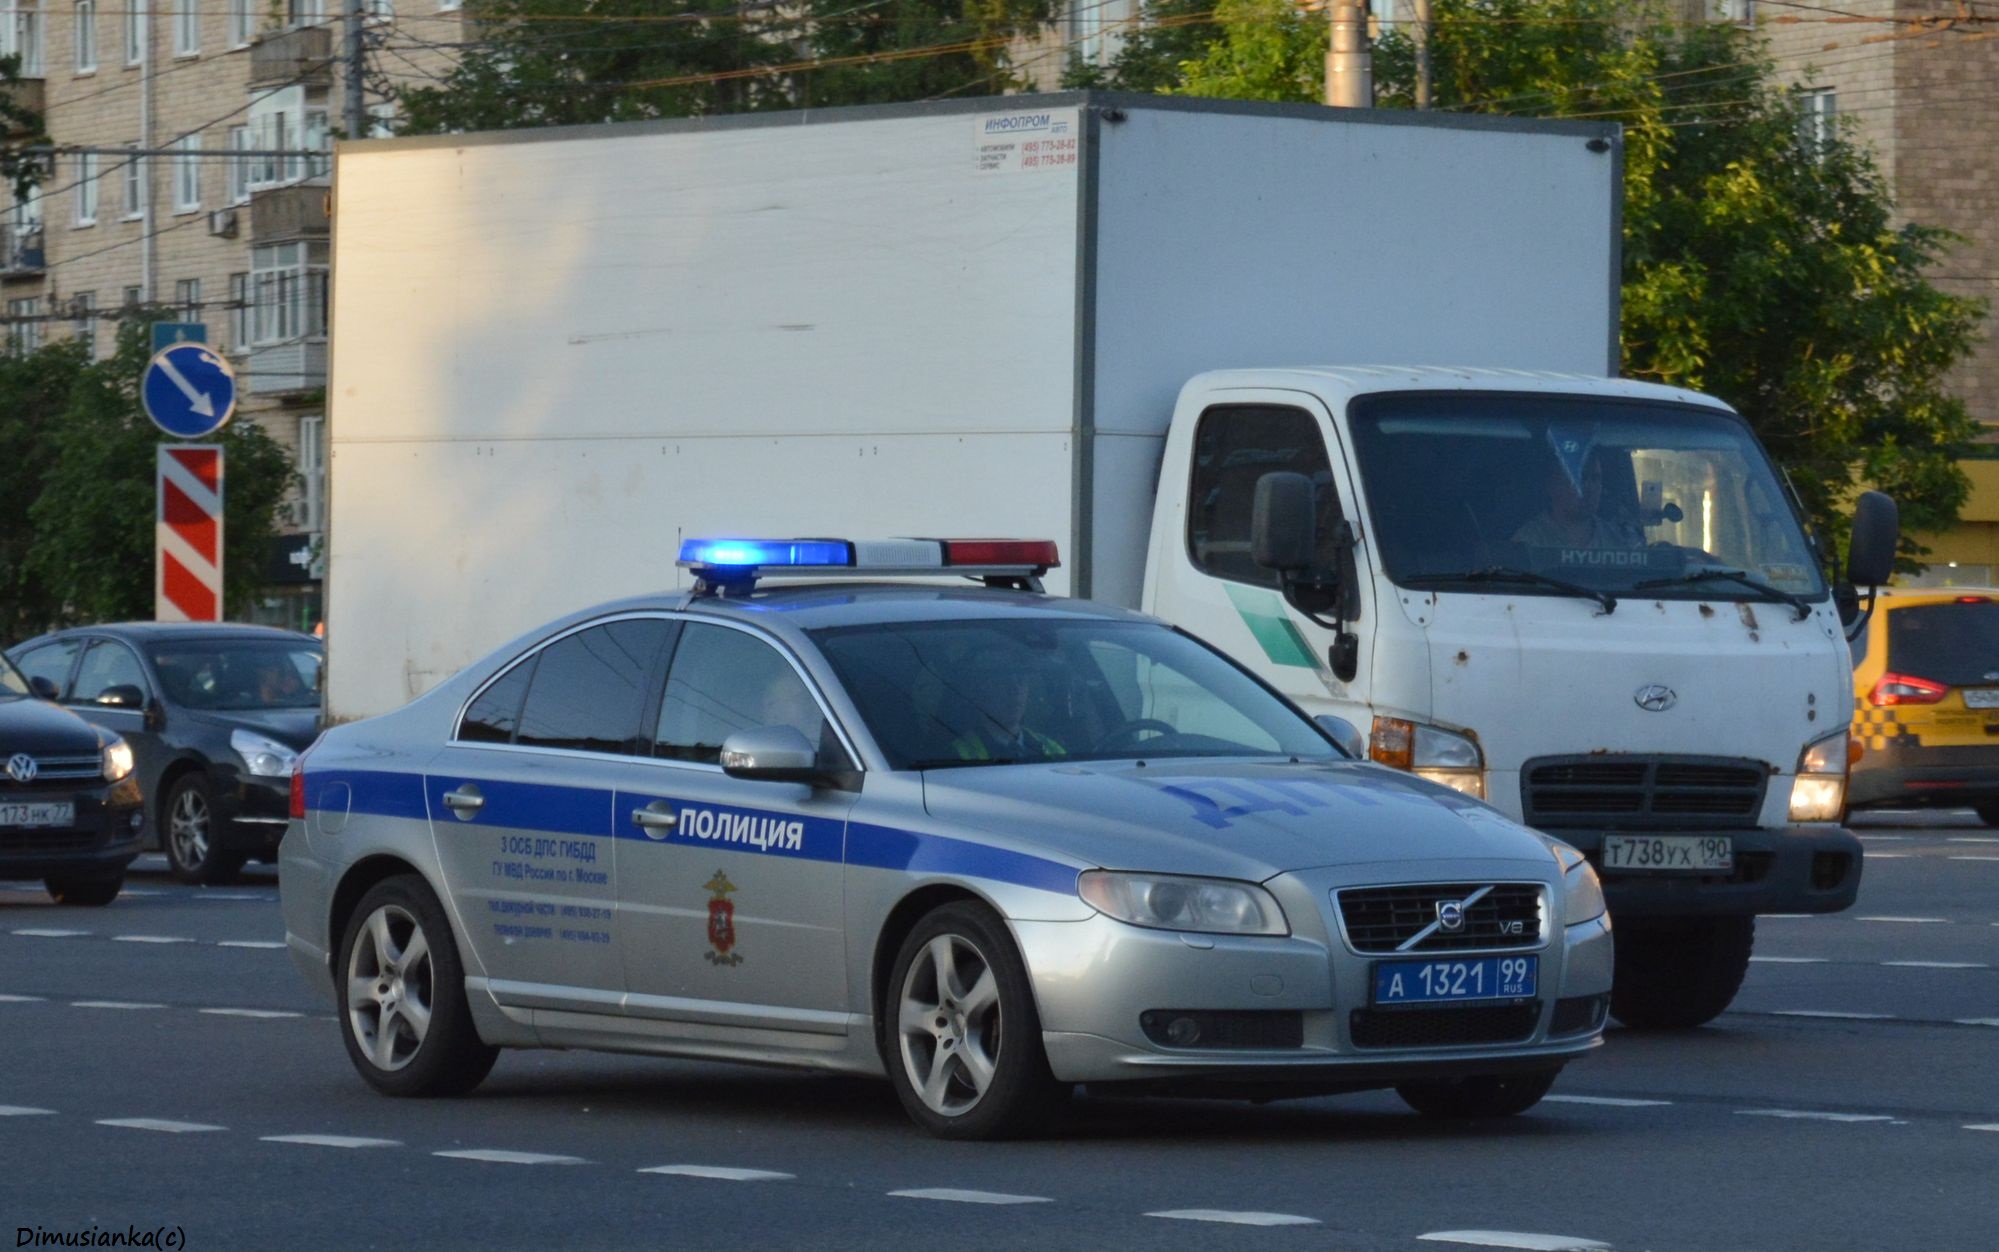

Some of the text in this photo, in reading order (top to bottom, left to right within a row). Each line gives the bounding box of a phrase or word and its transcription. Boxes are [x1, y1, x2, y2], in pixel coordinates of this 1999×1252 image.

[985, 114, 1051, 131] ИНФОПРОМ
[1560, 550, 1648, 565] HYUNDAI
[679, 808, 804, 851] ПОЛИЦИЯ
[501, 836, 596, 862] 3 ОСБ ДПС ГИБДД
[492, 861, 501, 876] ГУ
[504, 862, 523, 880] МВД
[525, 863, 555, 881] России
[1500, 921, 1523, 934] V8
[1419, 962, 1484, 995] 1321
[1501, 959, 1527, 984] 99
[1503, 984, 1523, 994] RUS
